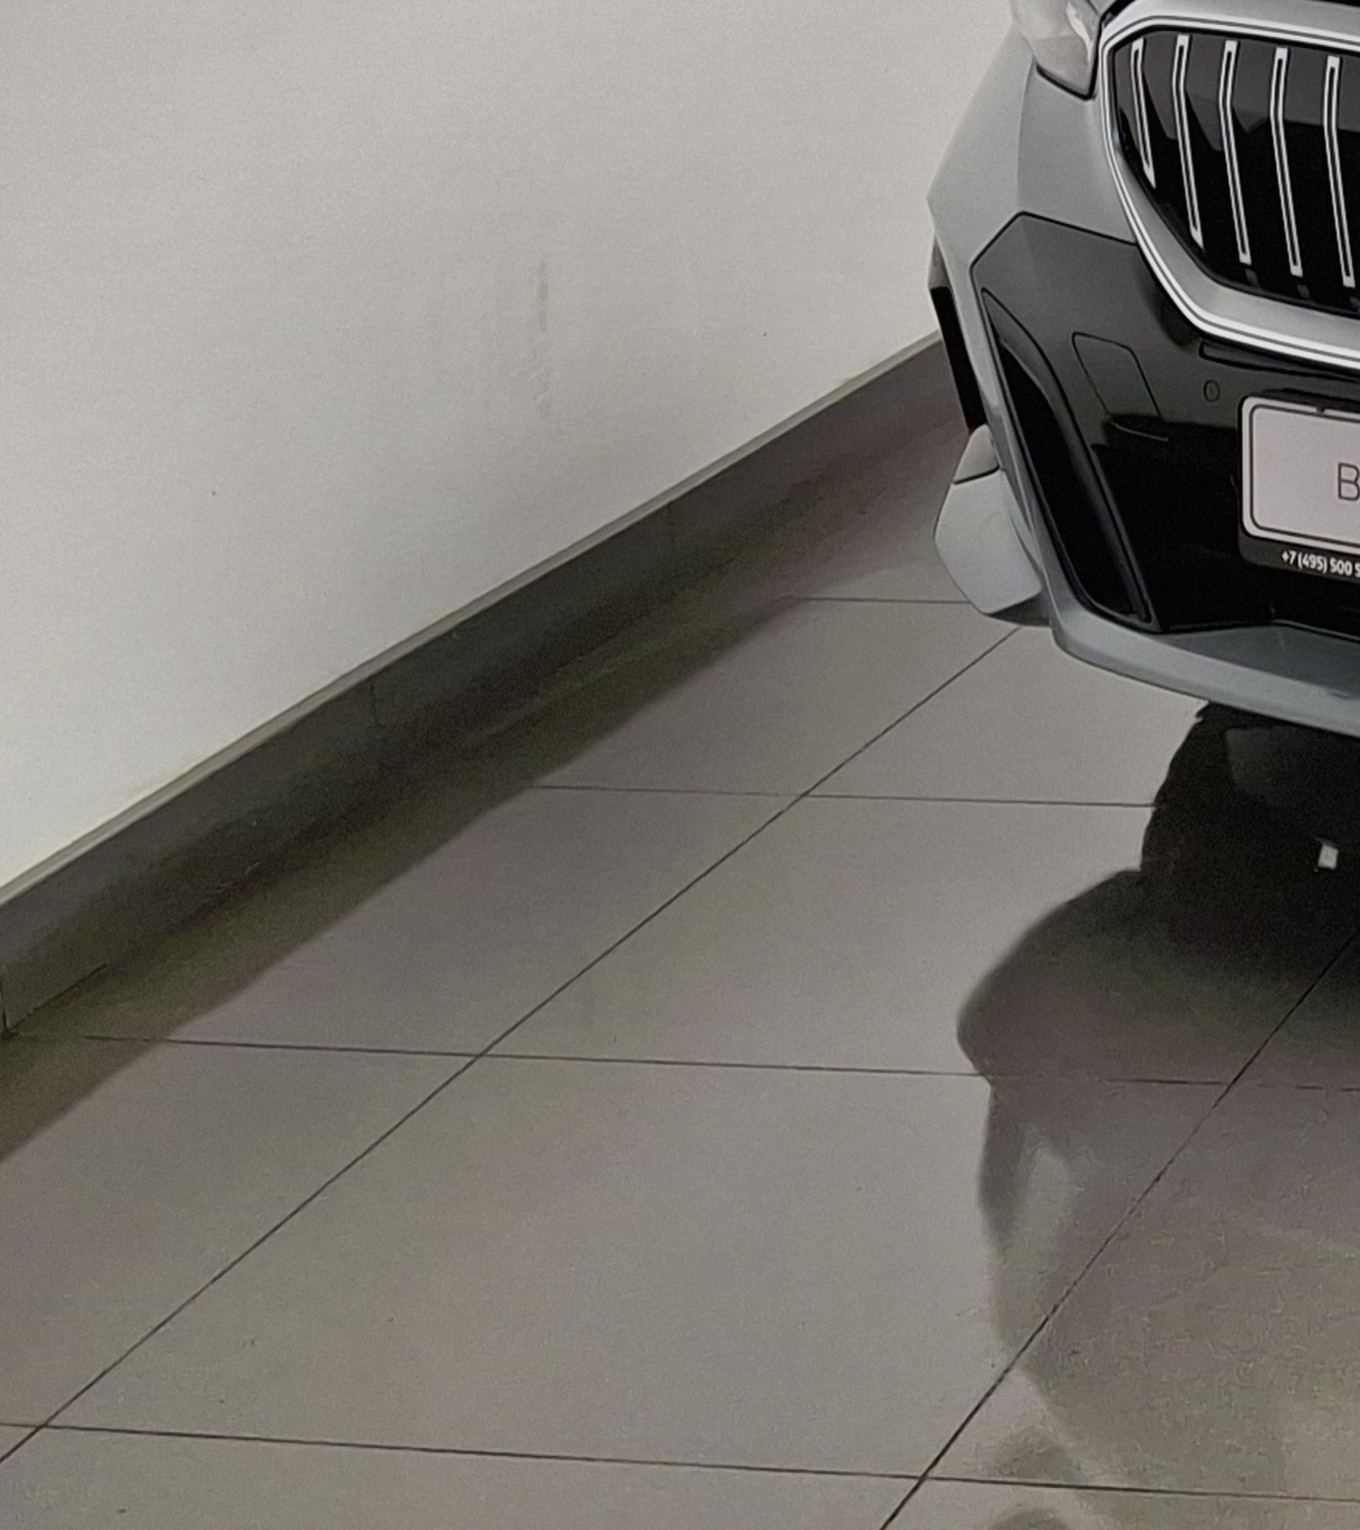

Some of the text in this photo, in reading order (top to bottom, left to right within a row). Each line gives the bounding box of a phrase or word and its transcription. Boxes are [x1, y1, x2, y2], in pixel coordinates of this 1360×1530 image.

[1281, 550, 1297, 566] +7
[1297, 552, 1328, 574] (495)
[1329, 558, 1352, 577] 500
